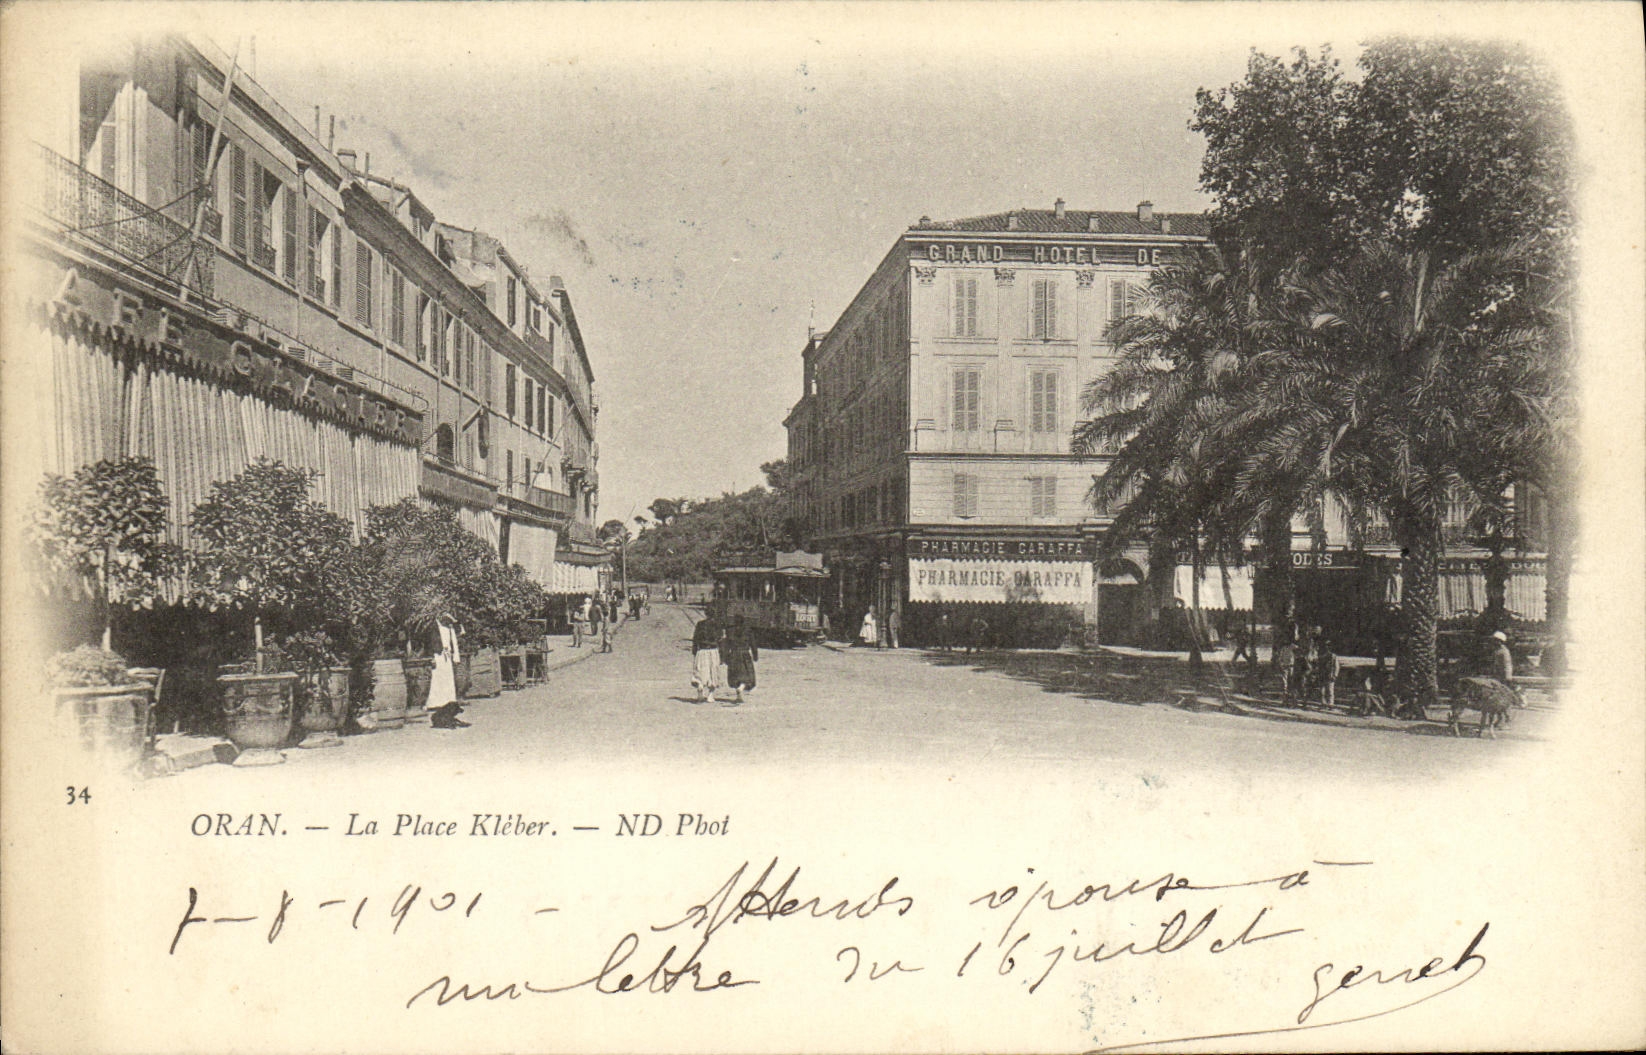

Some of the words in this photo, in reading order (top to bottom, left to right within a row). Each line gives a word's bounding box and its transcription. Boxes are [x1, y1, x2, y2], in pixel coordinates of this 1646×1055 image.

[928, 244, 1004, 262] GRAND
[1033, 246, 1101, 265] HOTEL
[1136, 248, 1161, 265] DE
[920, 541, 1005, 554] PHARMACIE
[1017, 542, 1083, 554] CARAFFA
[1288, 552, 1333, 566] ODES
[917, 569, 1006, 587] PHARMACIE
[957, 933, 1031, 978] 16
